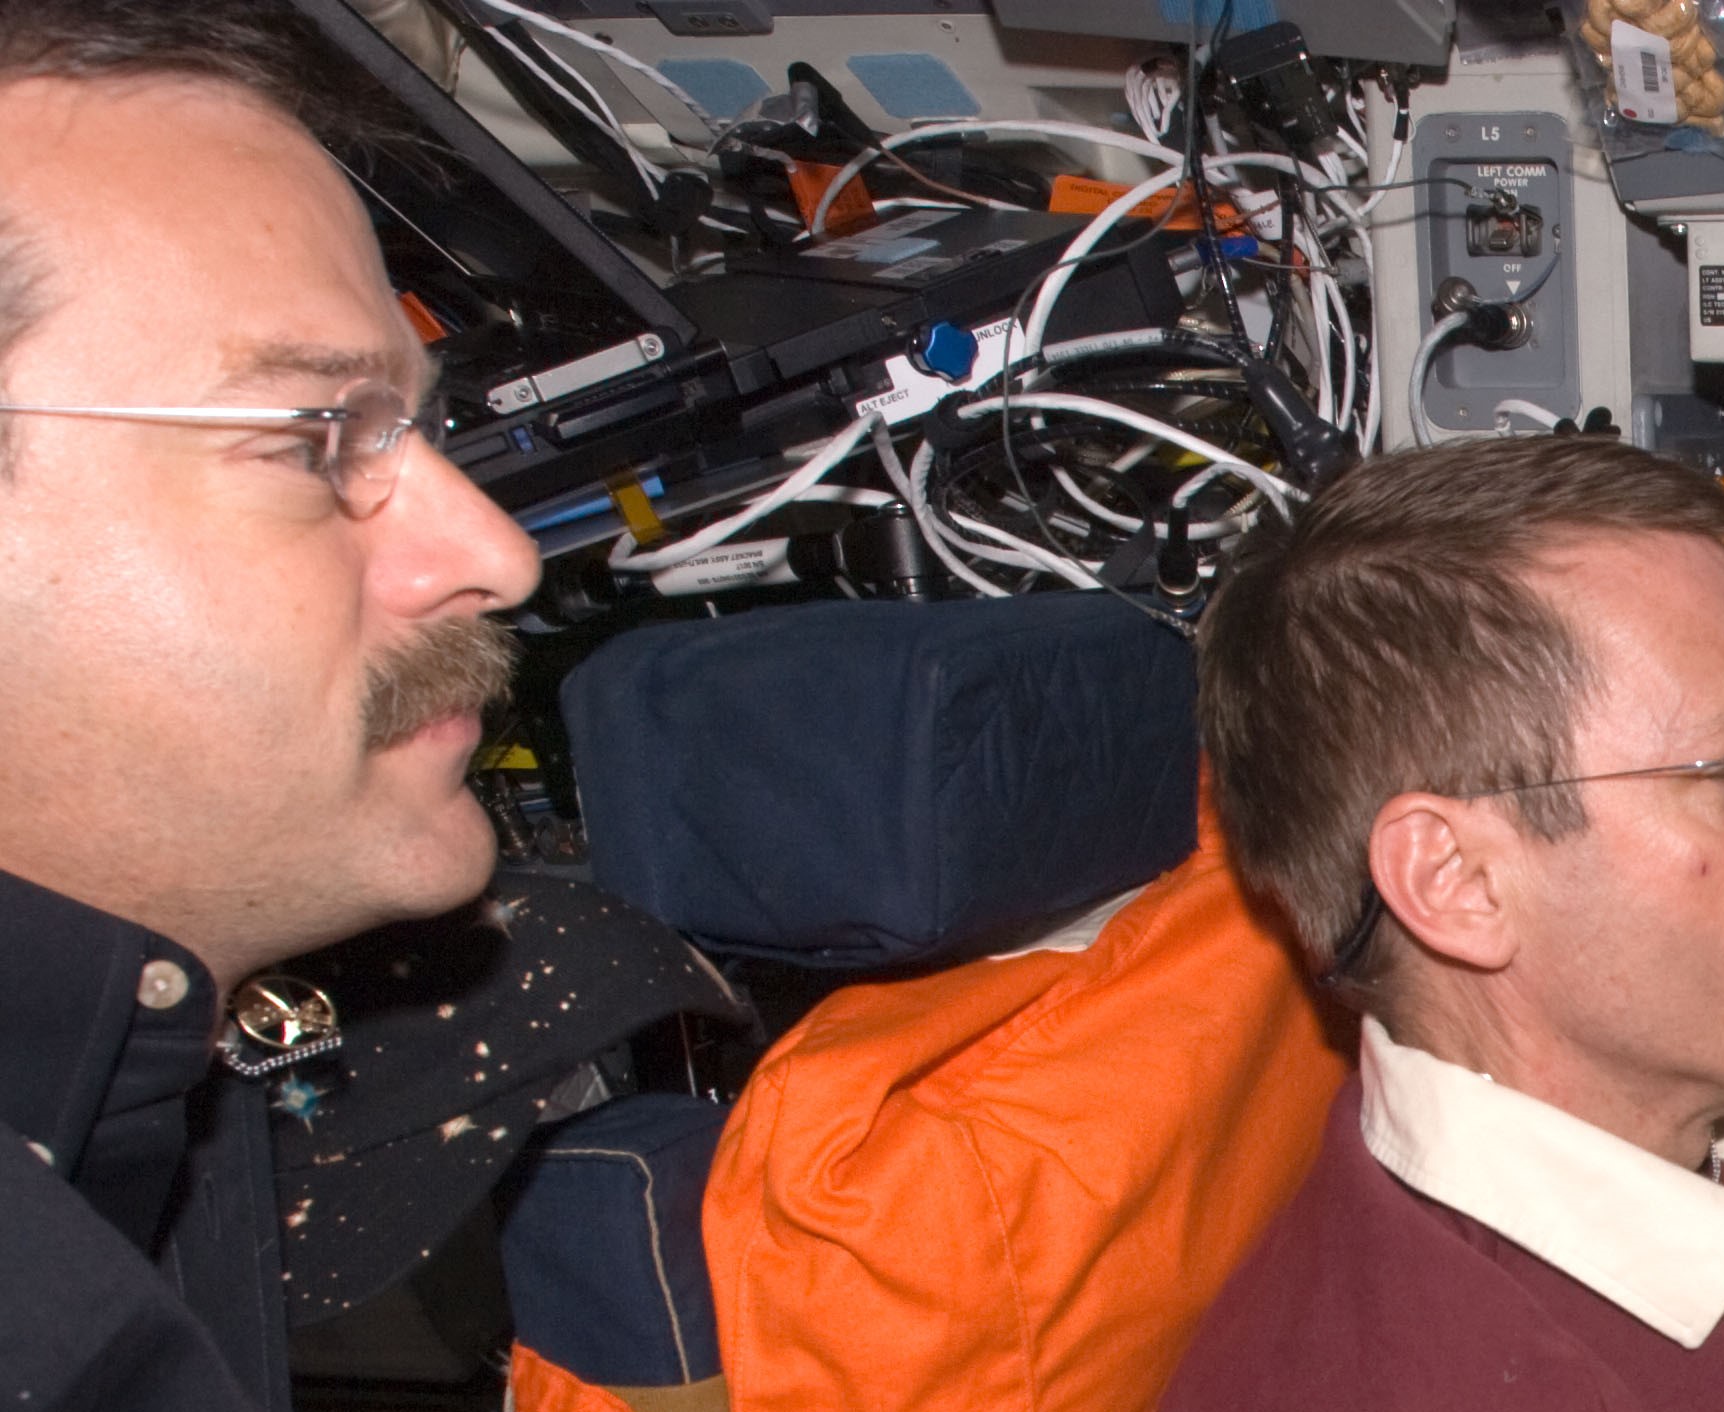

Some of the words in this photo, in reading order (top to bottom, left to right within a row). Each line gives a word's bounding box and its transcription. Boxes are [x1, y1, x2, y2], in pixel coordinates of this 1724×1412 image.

[1481, 126, 1500, 141] L5
[1477, 166, 1502, 177] LEFT
[1506, 166, 1547, 177] COMM
[1493, 178, 1529, 188] POWER
[1503, 263, 1522, 273] OFF
[860, 399, 882, 415] ALT
[879, 388, 910, 408] EJECT
